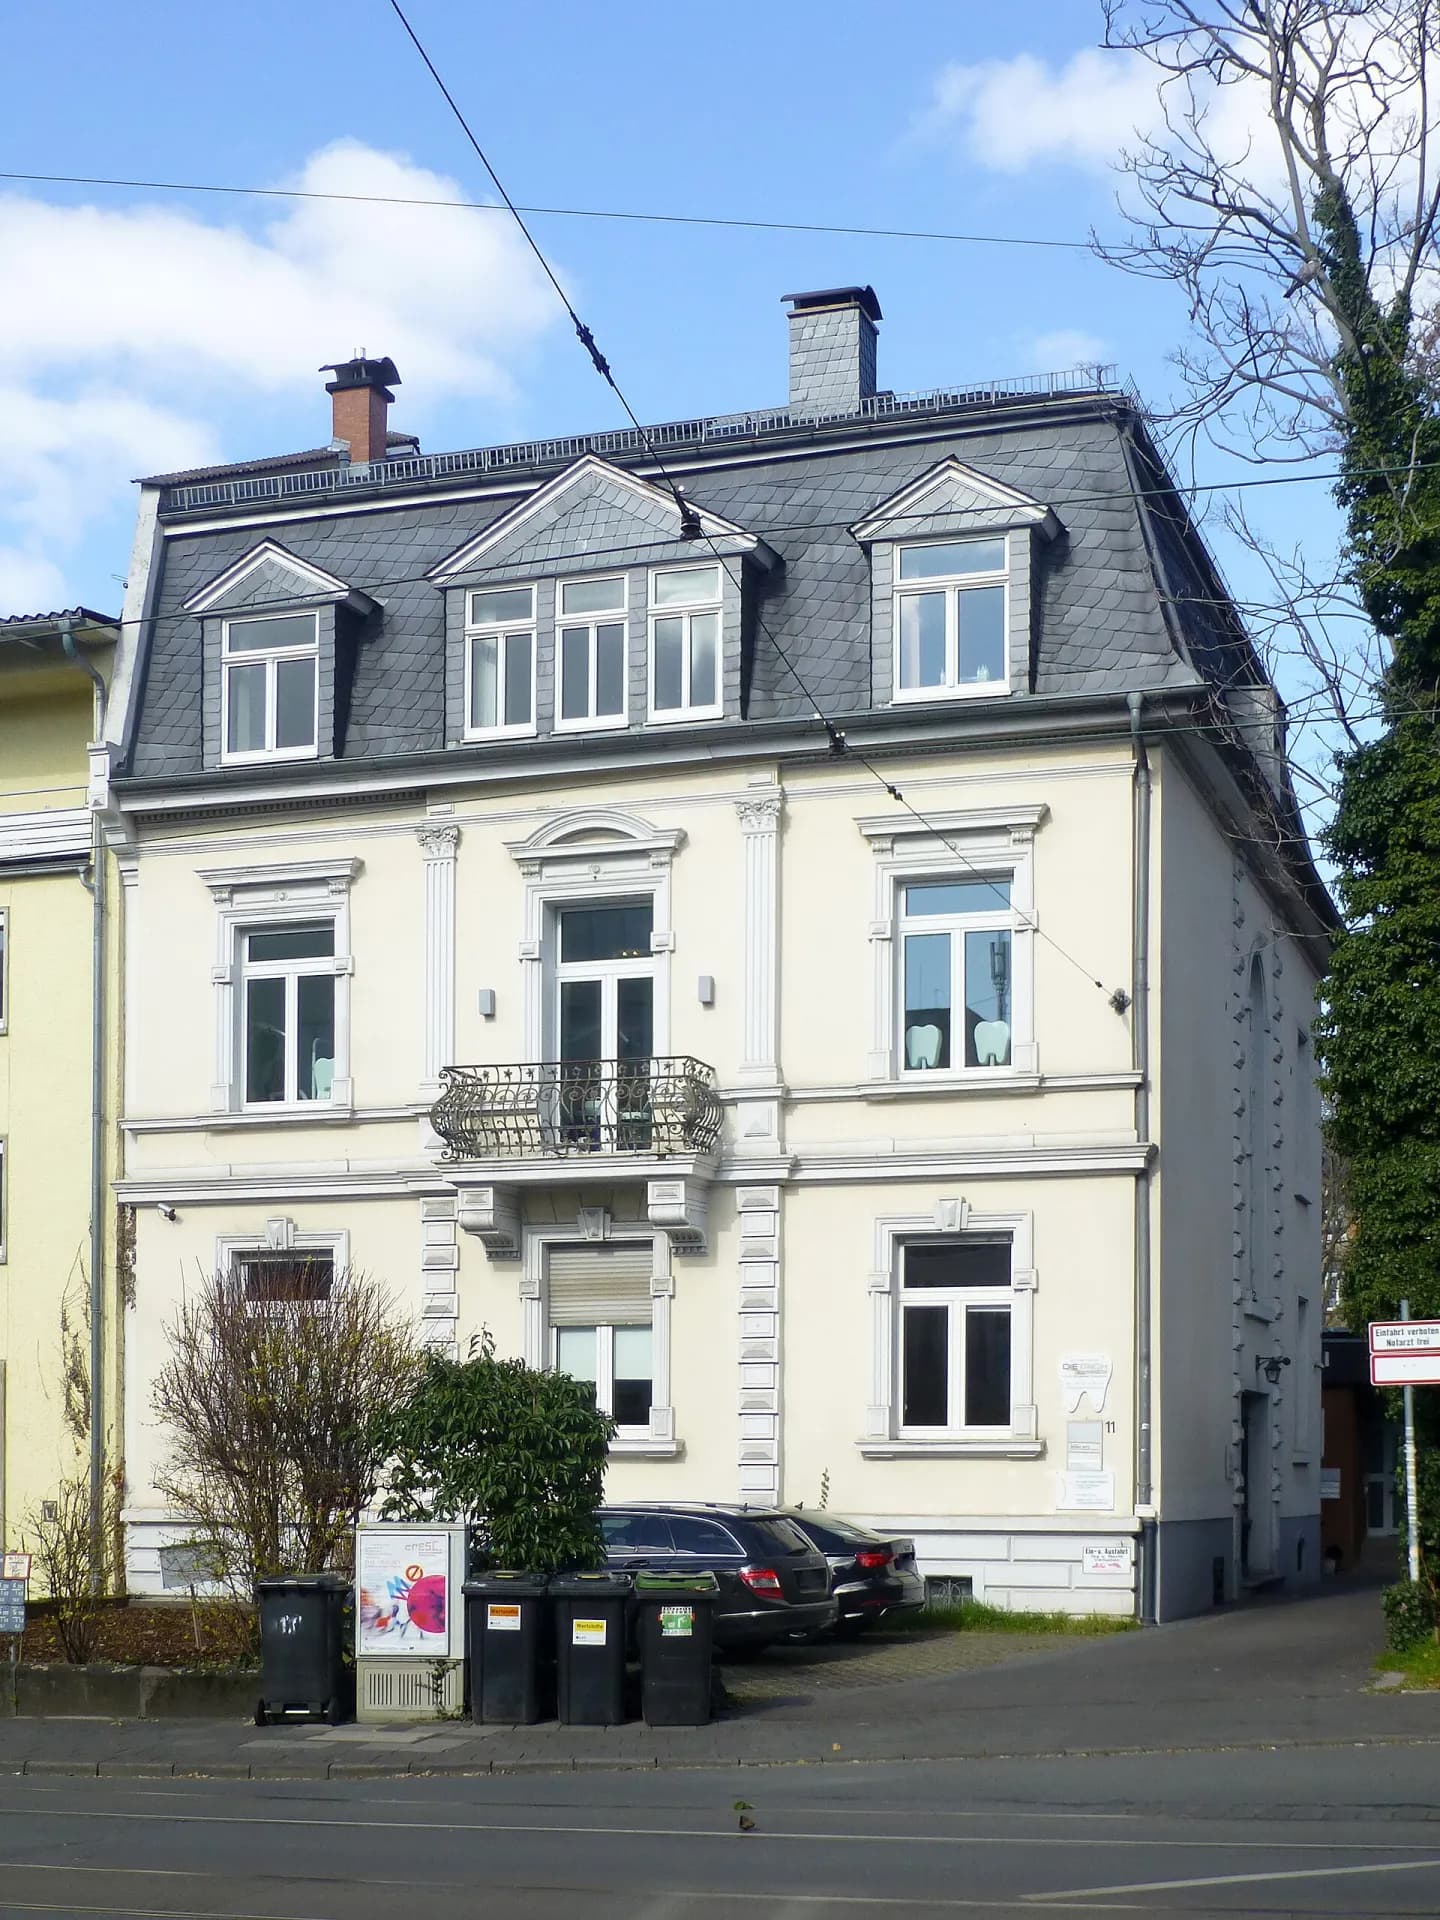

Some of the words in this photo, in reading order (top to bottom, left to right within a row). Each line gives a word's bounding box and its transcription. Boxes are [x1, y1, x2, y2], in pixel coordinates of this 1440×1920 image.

[1376, 1328, 1404, 1337] Einfahrt
[1408, 1328, 1439, 1336] verboten
[1386, 1338, 1413, 1346] Notarzt
[1105, 1420, 1116, 1433] 11
